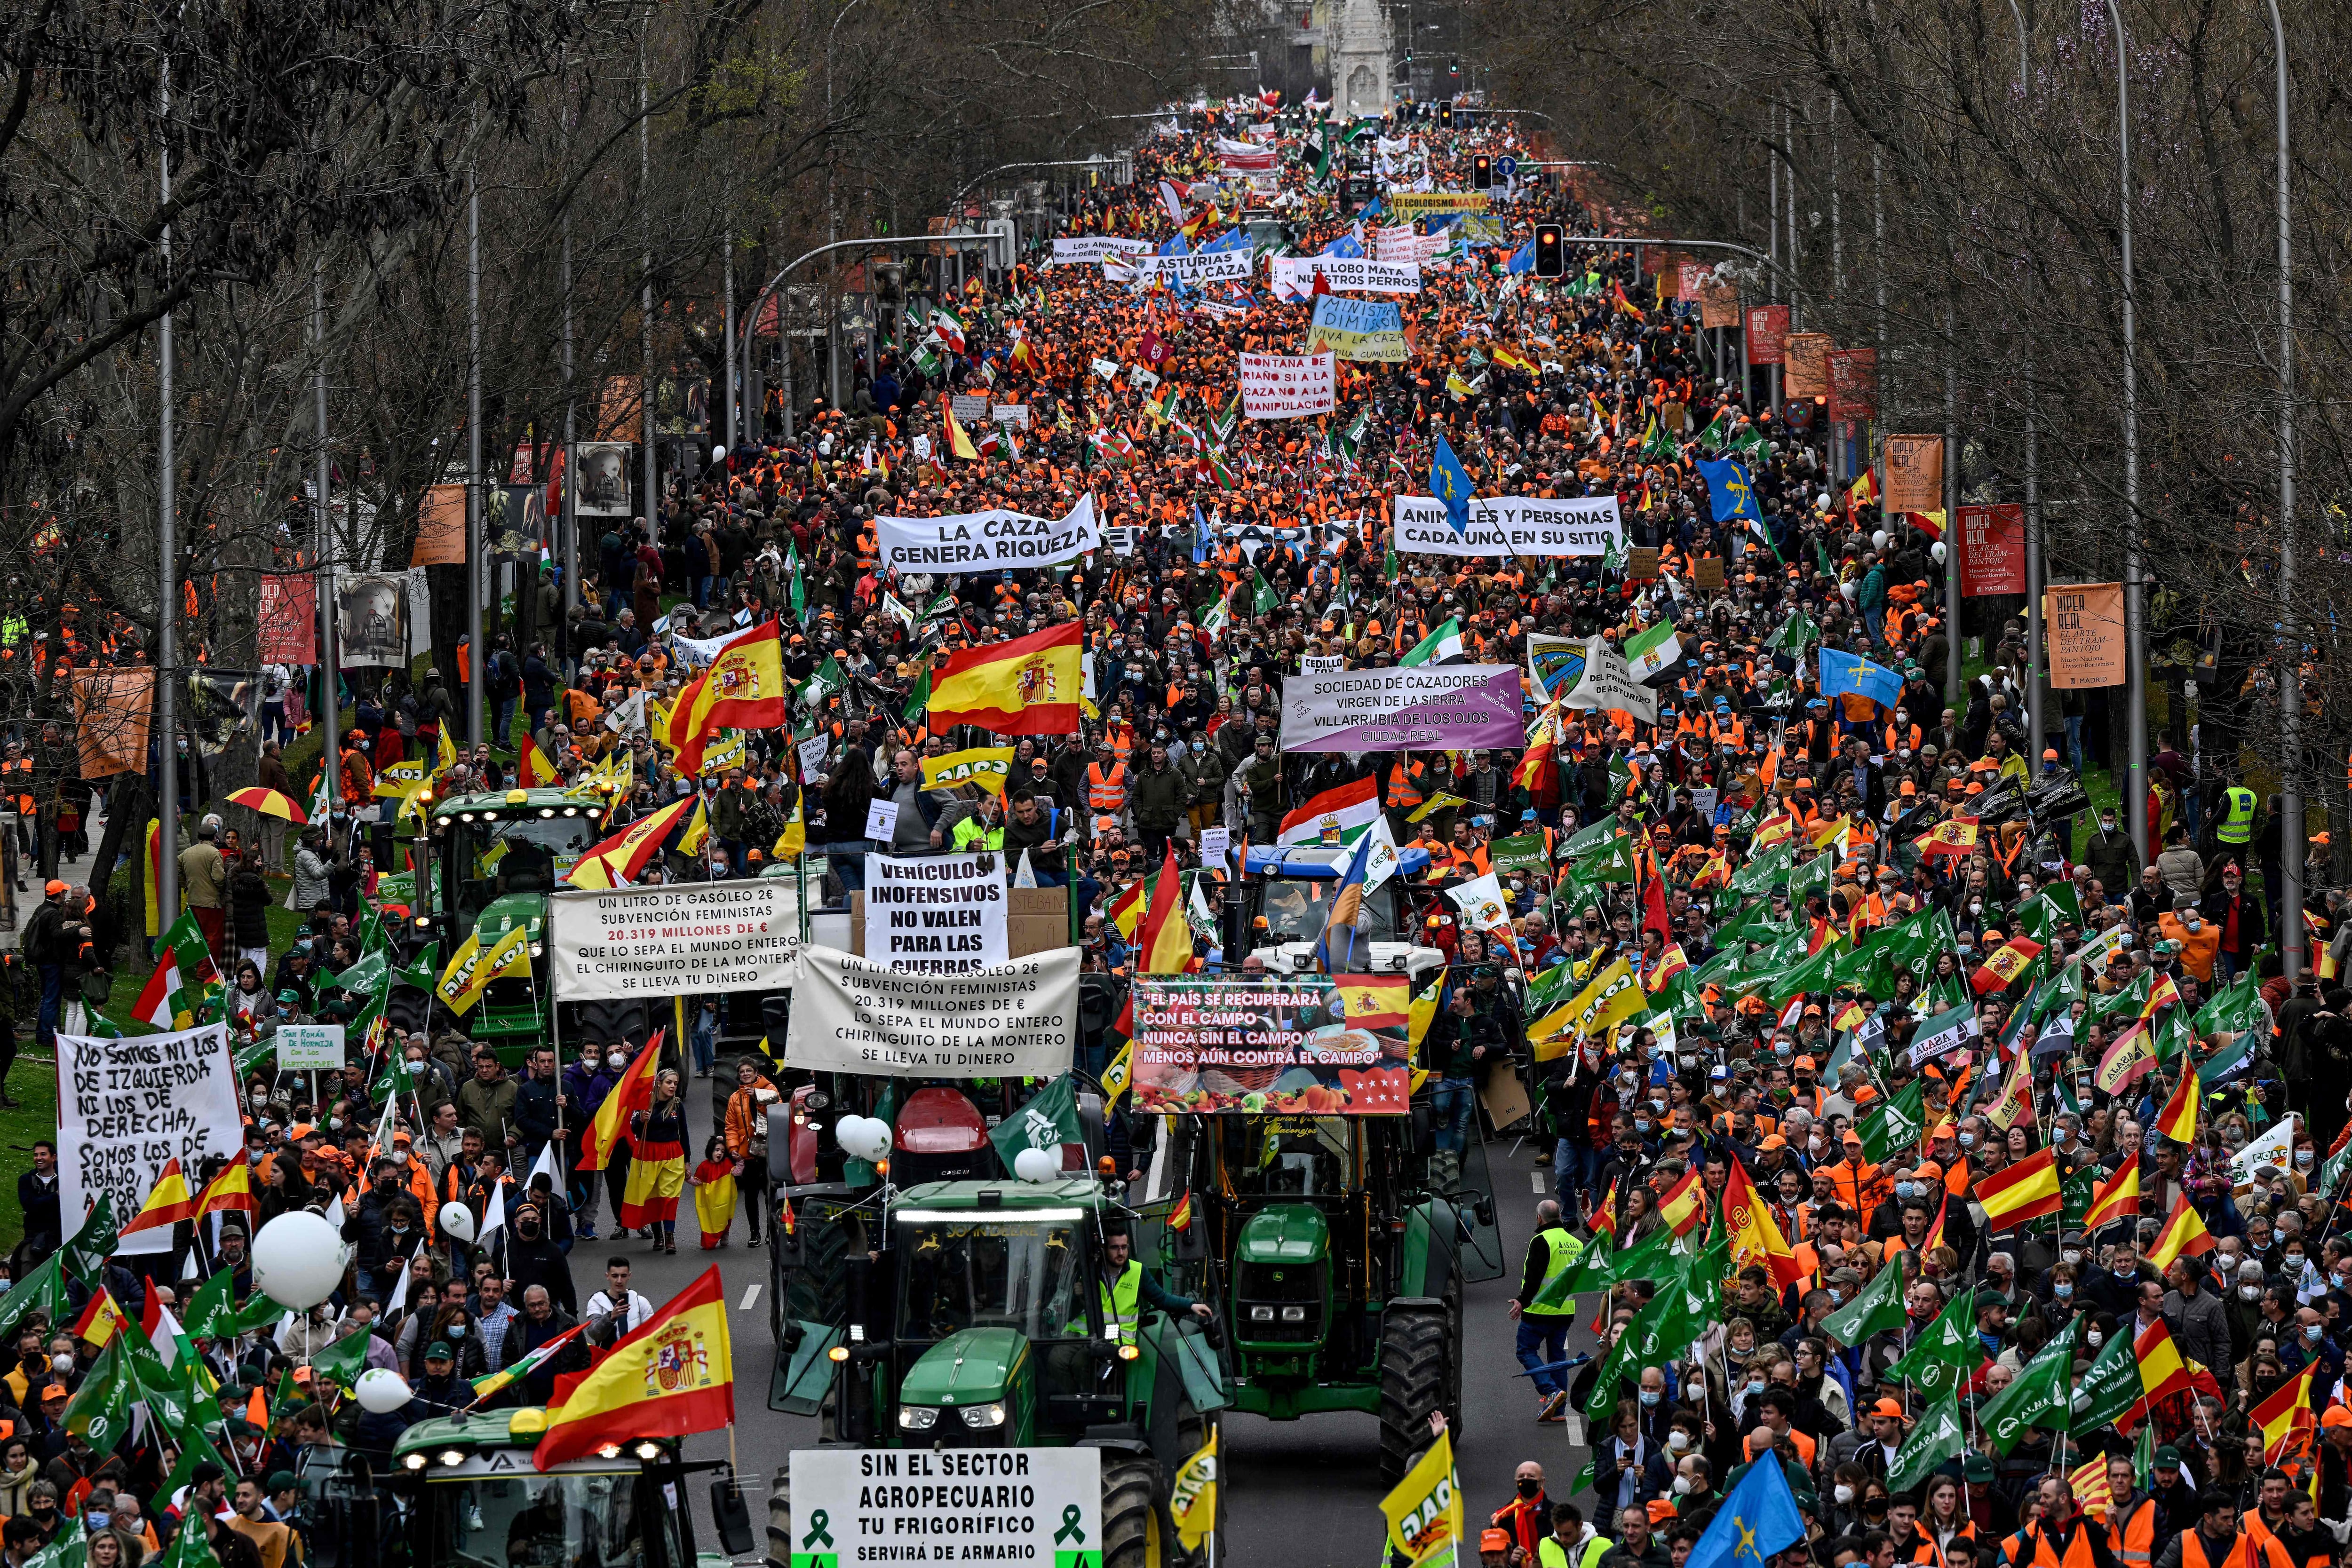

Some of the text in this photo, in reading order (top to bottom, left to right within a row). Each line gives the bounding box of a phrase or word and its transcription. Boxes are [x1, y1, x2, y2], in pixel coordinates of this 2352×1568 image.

[1453, 198, 1486, 207] MATA
[1093, 243, 1135, 252] ANIMALES
[1157, 254, 1232, 269] ASTURIAS
[1181, 266, 1200, 280] LA
[1205, 264, 1247, 277] CAZA
[1312, 264, 1404, 276] EL LOBO MATA
[1298, 275, 1418, 286] NUSTROS PERROS
[1323, 298, 1395, 316] MINISTRA
[1313, 327, 1342, 341] VIVA
[1374, 333, 1405, 342] CAZA
[1245, 357, 1304, 368] MONTAÑA
[1243, 371, 1279, 381] RIAÑO
[1314, 372, 1328, 380] LA
[1244, 388, 1275, 396] CAZA
[1314, 386, 1327, 395] LA
[1246, 397, 1330, 411] MANIPULACIÓN
[1402, 509, 1613, 524] ANIMLES Y PERSONAS
[1966, 515, 1989, 530] HIPER
[939, 520, 1050, 542] LA CAZA
[1406, 529, 1613, 545] CADA UNO EN SU SITIO
[1967, 530, 1987, 545] REAL
[891, 526, 1089, 563] GENERA RIQUEZA
[2057, 594, 2085, 612] HIPER
[2058, 613, 2083, 629] REAL
[2060, 644, 2100, 653] PANTOJO
[2061, 661, 2114, 670] Thyssen-Bornemisza
[1314, 675, 1489, 694] SOCIEDAD DE CAZADORES
[1337, 694, 1466, 708] VIRGEN DE LA SIERRA
[1314, 711, 1489, 727] VILLARRUBIA DE LOS OJOS
[1361, 730, 1443, 742] CIUDAD REAL
[802, 737, 826, 752] SIN AGUA
[807, 747, 825, 761] NO HAY
[880, 861, 988, 881] VEHÍCULOS
[599, 889, 772, 908] UN LITRO DE GASÓLEO 2€
[872, 884, 1000, 903] INOFENSIVOS
[602, 906, 771, 924] SUBVENCIÓN FEMINISTAS
[891, 910, 981, 927] NO VALEN
[608, 922, 767, 940] 20.319 MILLONES DE €
[579, 936, 798, 957] QUE LO SEPA EL MUNDO ENTERO
[891, 934, 983, 952] PARA LAS
[623, 971, 757, 988] SE LLEVA TU DINERO
[1169, 990, 1201, 1006] PAÍS
[1205, 994, 1220, 1006] SE
[1224, 990, 1321, 1006] RECUPERARÁ
[1143, 1012, 1257, 1025] CON EL CAMPO
[1143, 1031, 1316, 1045] NUNCA SIN EL CAMPO Y
[1143, 1051, 1194, 1063] MENOS
[1199, 1048, 1229, 1063] AÚN
[1233, 1051, 1296, 1063] CONTRA
[1300, 1052, 1314, 1063] EL
[74, 1060, 211, 1093] DE IZQUIERDA
[77, 1089, 171, 1117] NI LOS DE
[2252, 1148, 2288, 1163] COAG
[2084, 1348, 2133, 1388] ASAJA
[2099, 1370, 2134, 1394] Valladolid
[861, 1453, 1028, 1476] SIN EL SECTOR
[859, 1485, 1033, 1508] AGROPECUARIO
[858, 1512, 1034, 1534] TU FRIGORÍFICO
[858, 1542, 1034, 1560] SERVIRÁ DE ARMARIO
